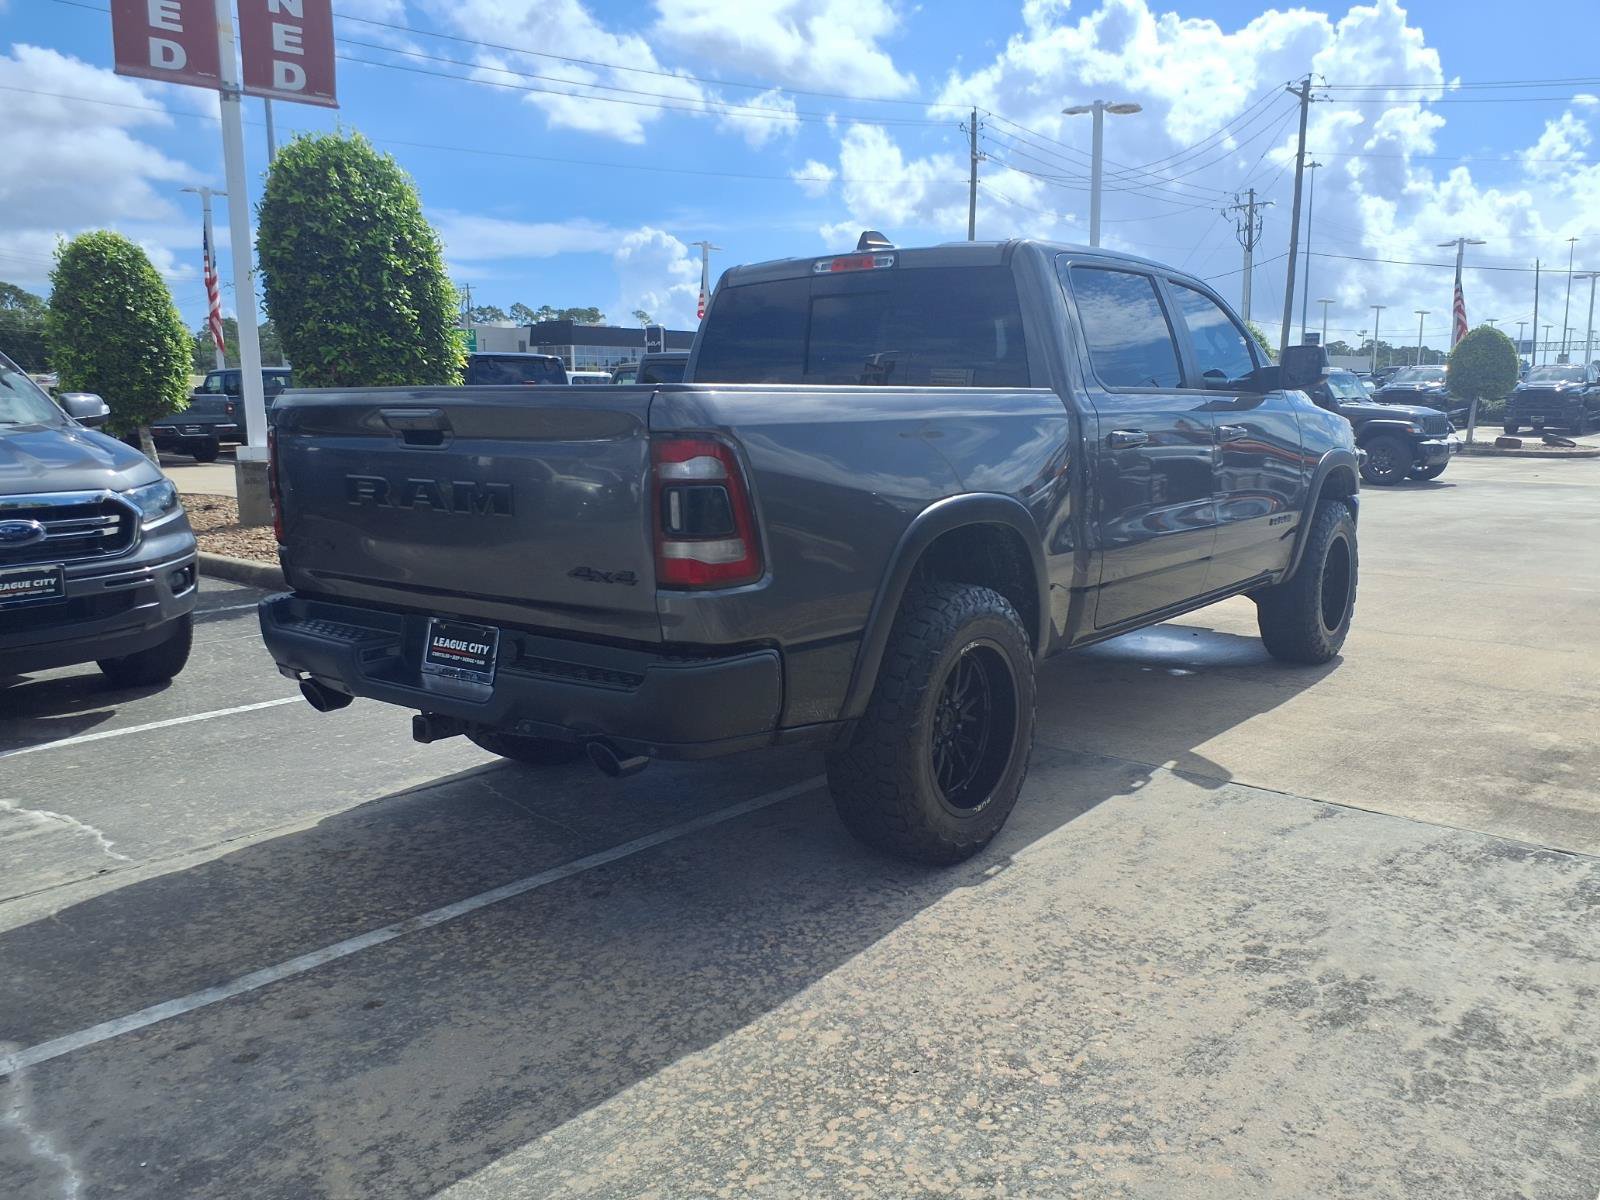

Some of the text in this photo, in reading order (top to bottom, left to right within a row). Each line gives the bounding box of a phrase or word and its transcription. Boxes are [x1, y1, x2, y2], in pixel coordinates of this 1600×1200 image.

[346, 474, 514, 517] RAM
[33, 578, 57, 587] CITY
[433, 636, 490, 655] LEAGUE CITY
